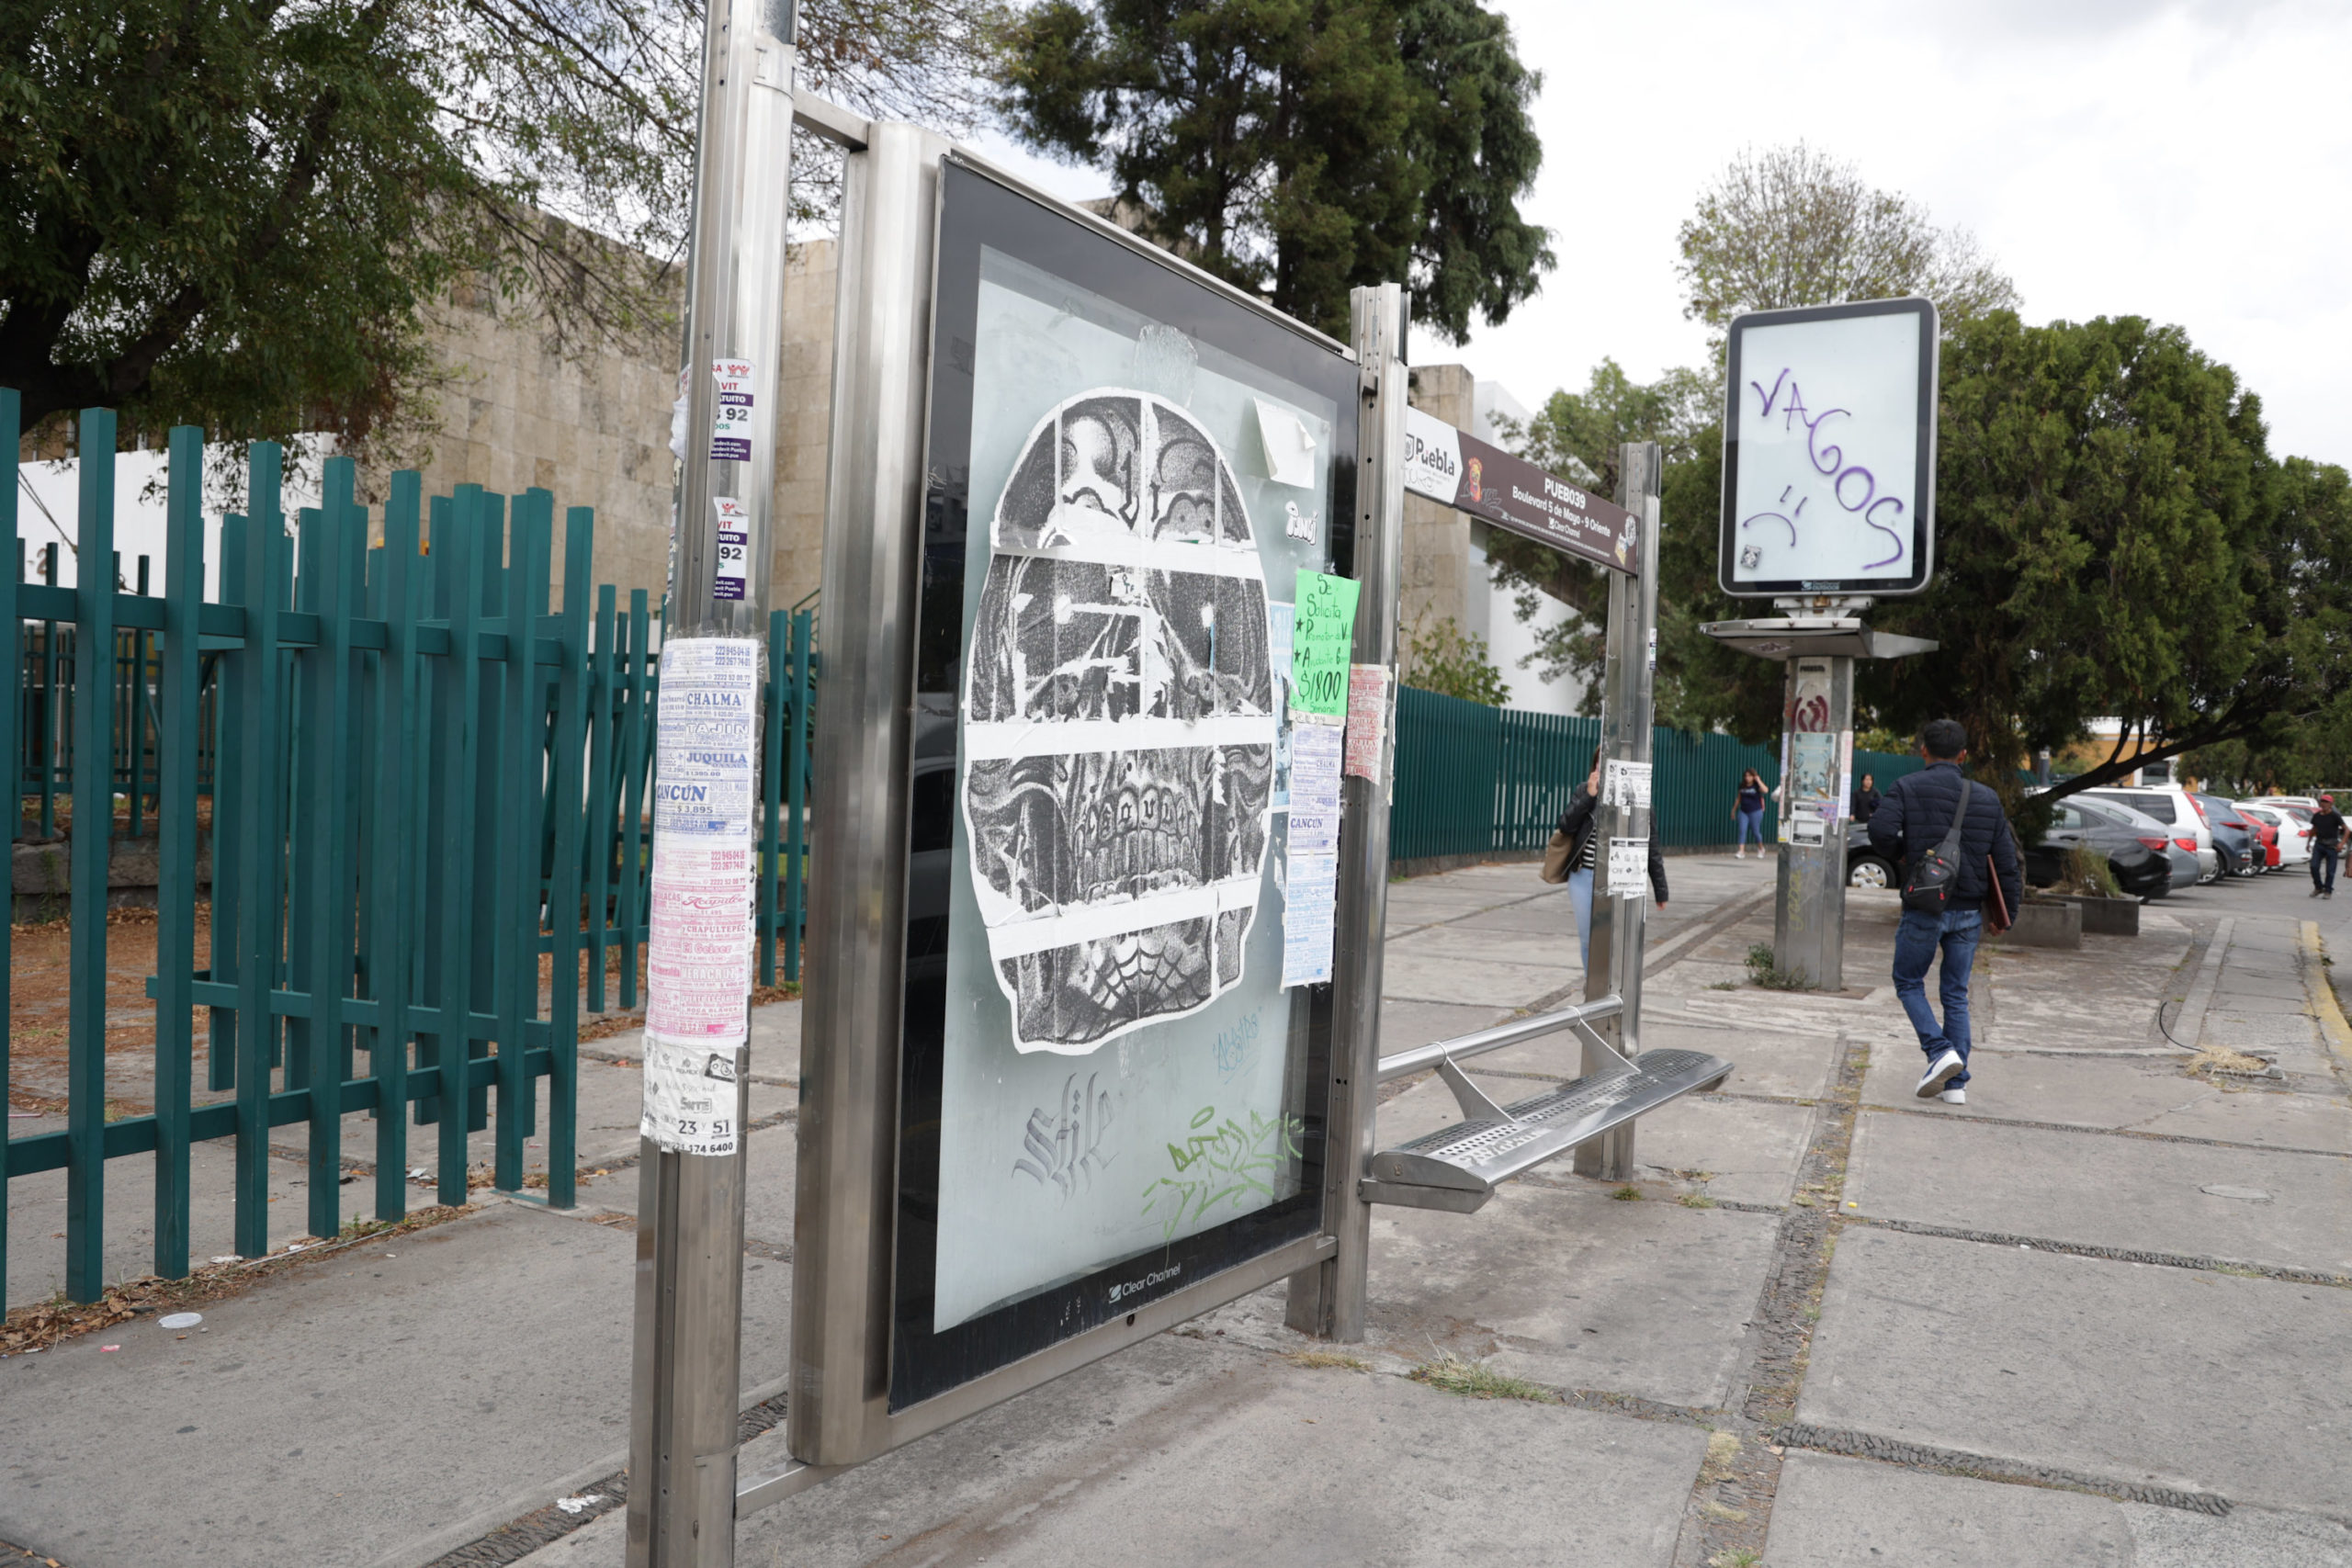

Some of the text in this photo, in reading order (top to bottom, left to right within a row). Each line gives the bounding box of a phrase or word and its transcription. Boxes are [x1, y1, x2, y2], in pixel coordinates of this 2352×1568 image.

[726, 408, 748, 422] 92
[1416, 437, 1454, 477] Puebla
[1750, 367, 1905, 570] VAGOS
[1544, 478, 1587, 510] PUEB039
[1512, 485, 1547, 511] Boulevard
[1548, 501, 1554, 513] 5
[1554, 504, 1562, 516] de
[1563, 507, 1580, 525] Mayo
[1584, 516, 1589, 528] 9
[1590, 519, 1611, 537] Oriente
[720, 546, 742, 560] 92
[1317, 573, 1332, 595] Se
[1306, 592, 1340, 619] Solicita
[1298, 670, 1341, 703] $1800
[687, 693, 741, 705] CHALMA
[687, 724, 749, 735] TAJIN
[686, 752, 748, 764] JUQUILA
[711, 851, 720, 860] 222
[711, 862, 721, 870] 222
[682, 894, 745, 909] Acapulco
[678, 1120, 696, 1134] 23
[713, 1120, 729, 1134] 51
[709, 1142, 733, 1153] 6400
[1122, 1262, 1181, 1296] Clear Channel
